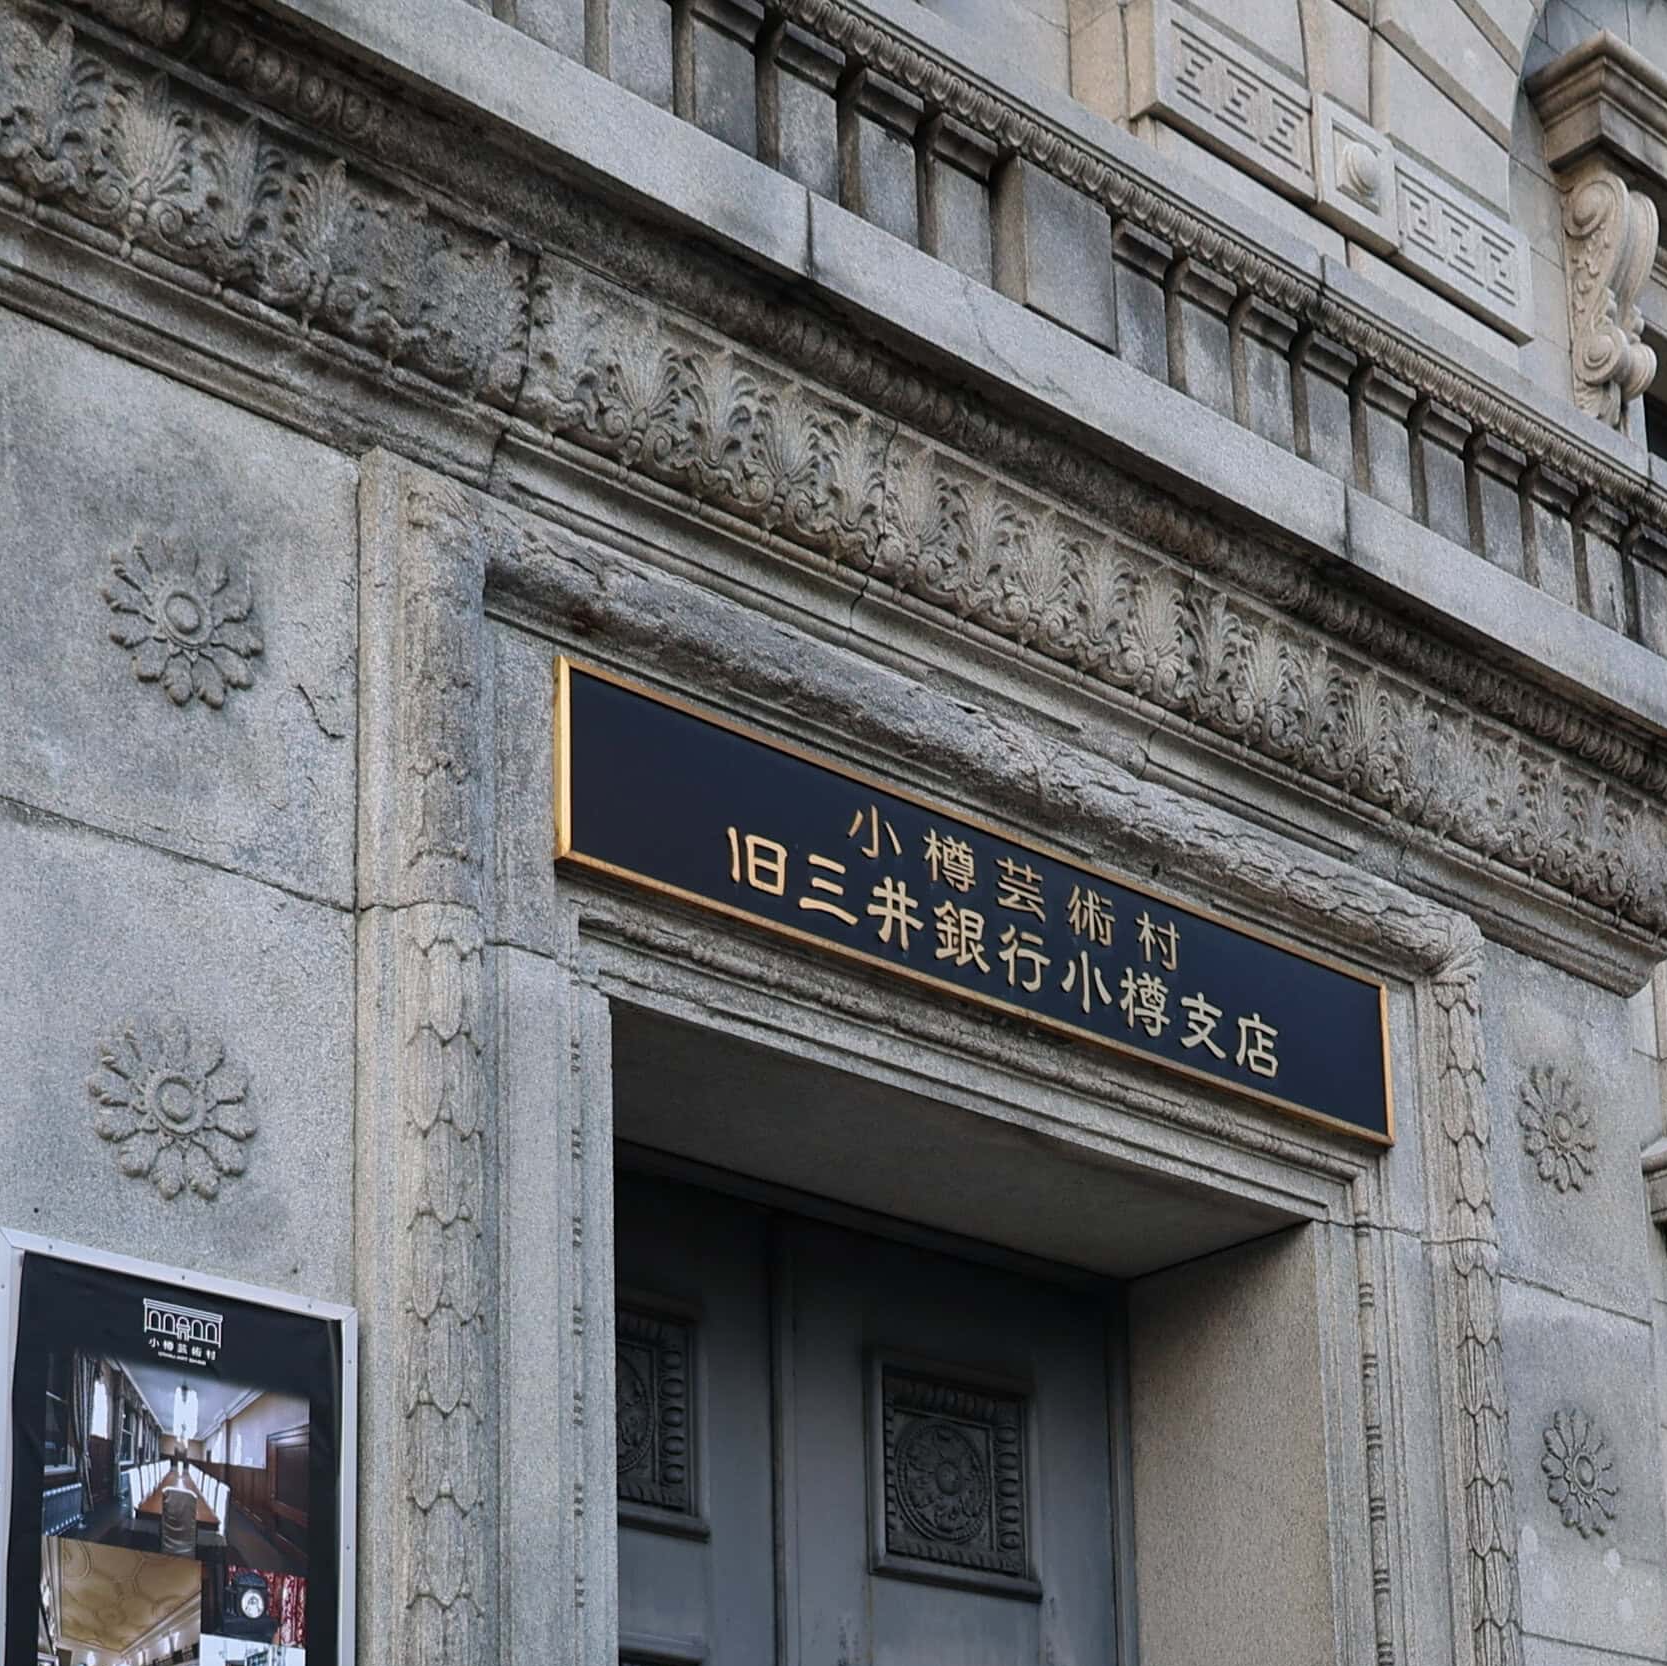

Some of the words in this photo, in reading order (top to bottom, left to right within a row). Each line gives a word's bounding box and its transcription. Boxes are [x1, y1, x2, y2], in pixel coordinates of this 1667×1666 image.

[726, 826, 1280, 1078] 旧三井銀行小樽支店
[847, 804, 1181, 972] 小樽芸術村
